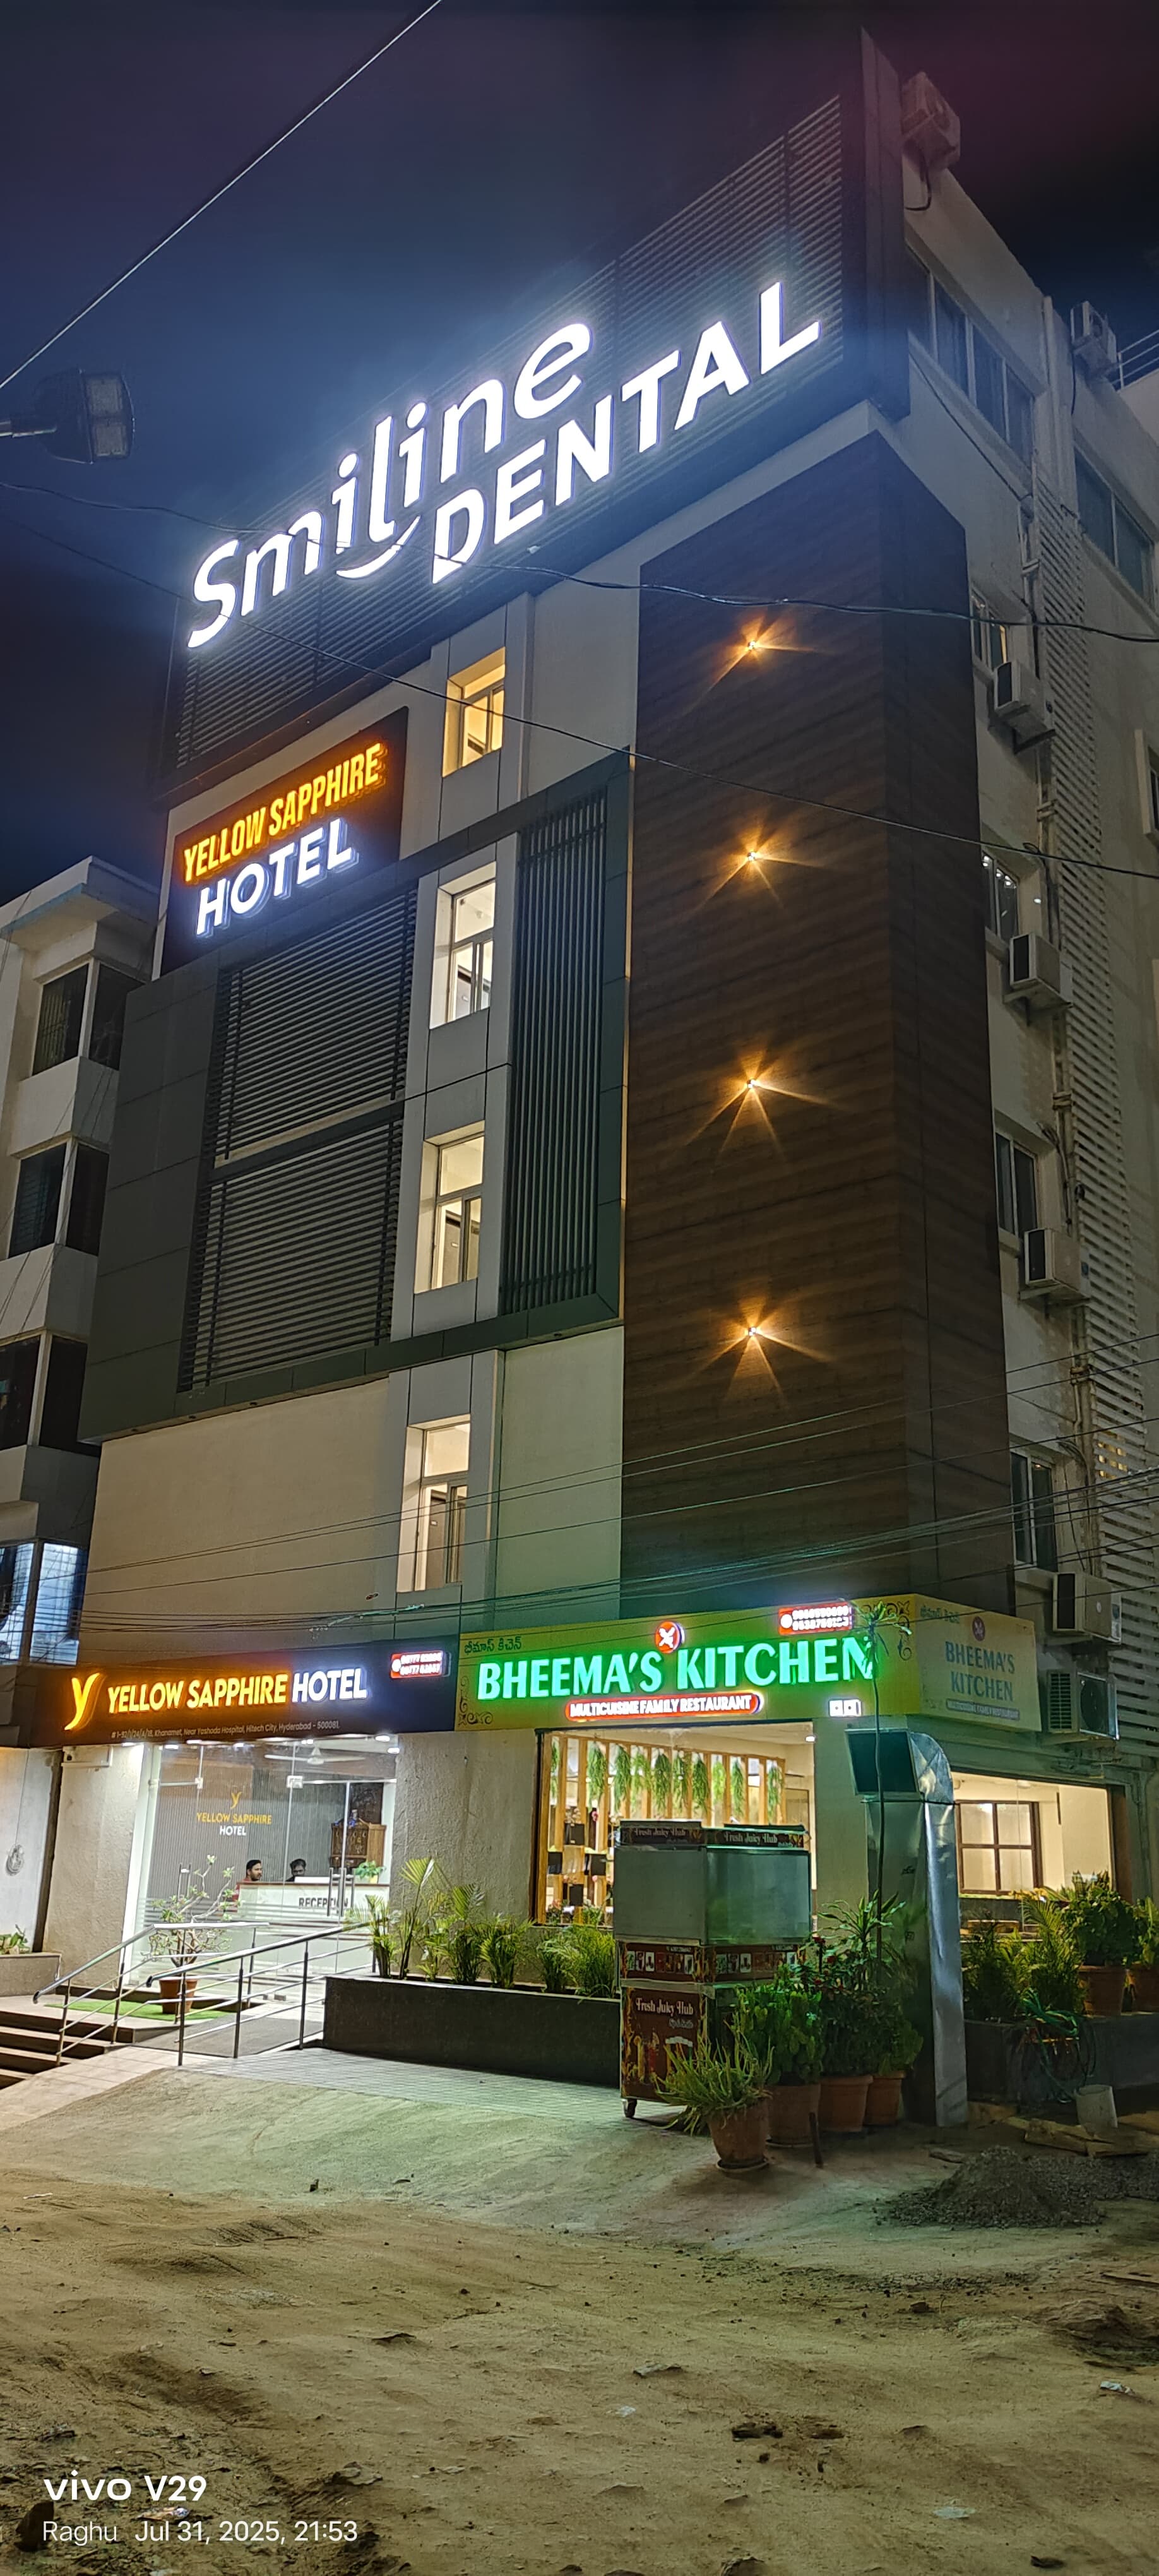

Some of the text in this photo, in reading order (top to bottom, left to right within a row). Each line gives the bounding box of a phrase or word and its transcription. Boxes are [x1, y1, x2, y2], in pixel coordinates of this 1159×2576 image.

[432, 282, 821, 584] DENTAL
[187, 323, 592, 648] Smiline
[184, 742, 383, 882] YELLOW SAPPHIRE
[196, 818, 354, 936] HOTEL
[477, 1635, 874, 1701] BHEEMA'S KITCHEN
[944, 1640, 1016, 1674] BHEEMA'S
[107, 1667, 367, 1714] YELLOW SAPPHIRE HOTEL
[950, 1671, 1014, 1702] KITCHEN
[640, 1698, 681, 1714] FAMILY
[680, 1695, 752, 1713] RESTAURANT
[184, 1727, 196, 1736] Near
[197, 1727, 221, 1736] Yashoda
[222, 1725, 245, 1735] Hospital,
[246, 1724, 264, 1732] Hitech
[265, 1724, 278, 1733] City,
[279, 1722, 312, 1733] Hyderabad
[197, 1812, 272, 1825] YELLOW SAPPHIRE
[219, 1825, 247, 1836] HOTEL
[725, 1832, 742, 1842] Fresh
[763, 1832, 778, 1844] Hub
[635, 1997, 656, 2012] Fresh
[676, 2001, 694, 2015] Hub
